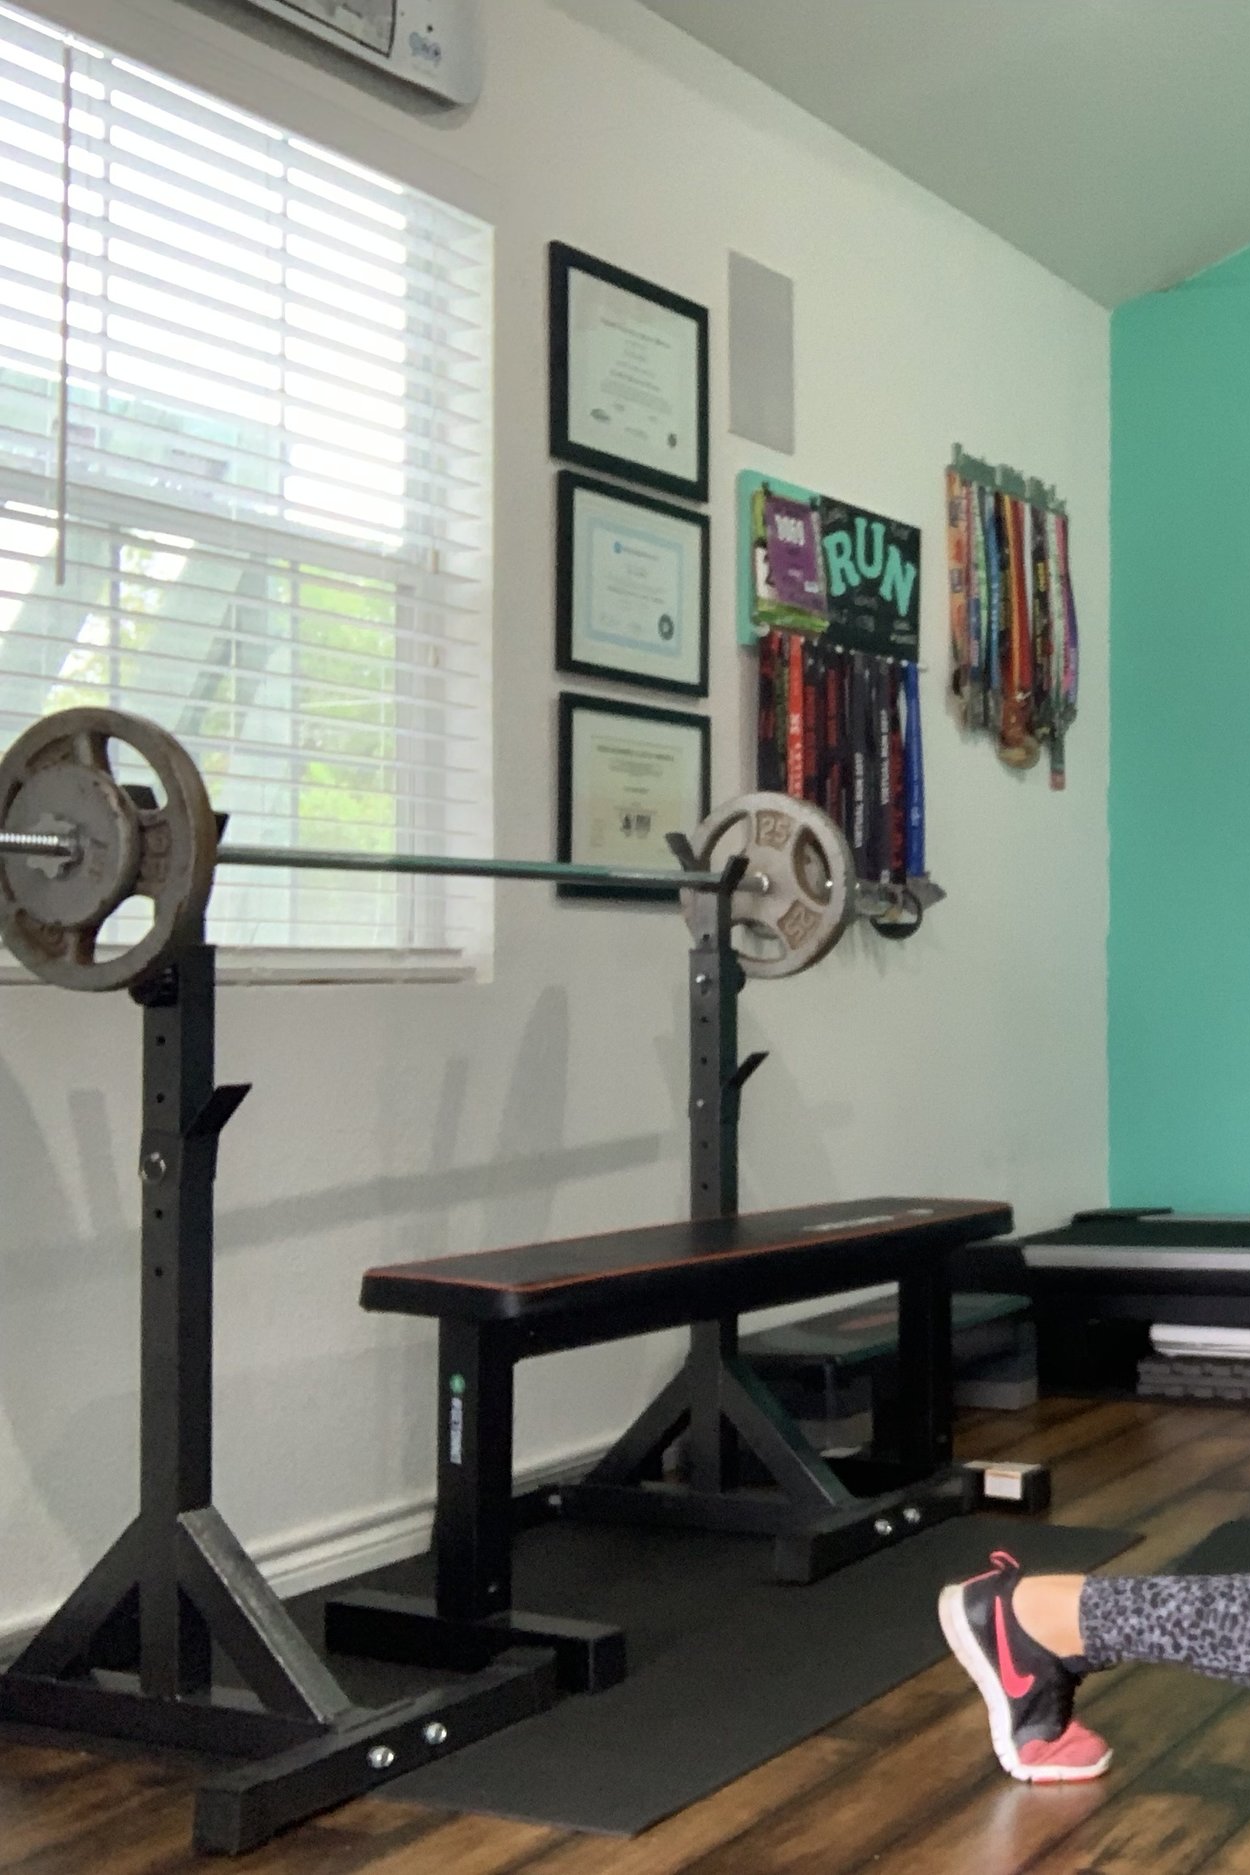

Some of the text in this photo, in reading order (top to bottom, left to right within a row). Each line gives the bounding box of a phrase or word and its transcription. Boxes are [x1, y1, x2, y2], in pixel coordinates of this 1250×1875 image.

[823, 517, 917, 616] RUN
[854, 779, 864, 802] RUN
[760, 814, 791, 843] 25
[854, 802, 864, 848] VIRTUAL
